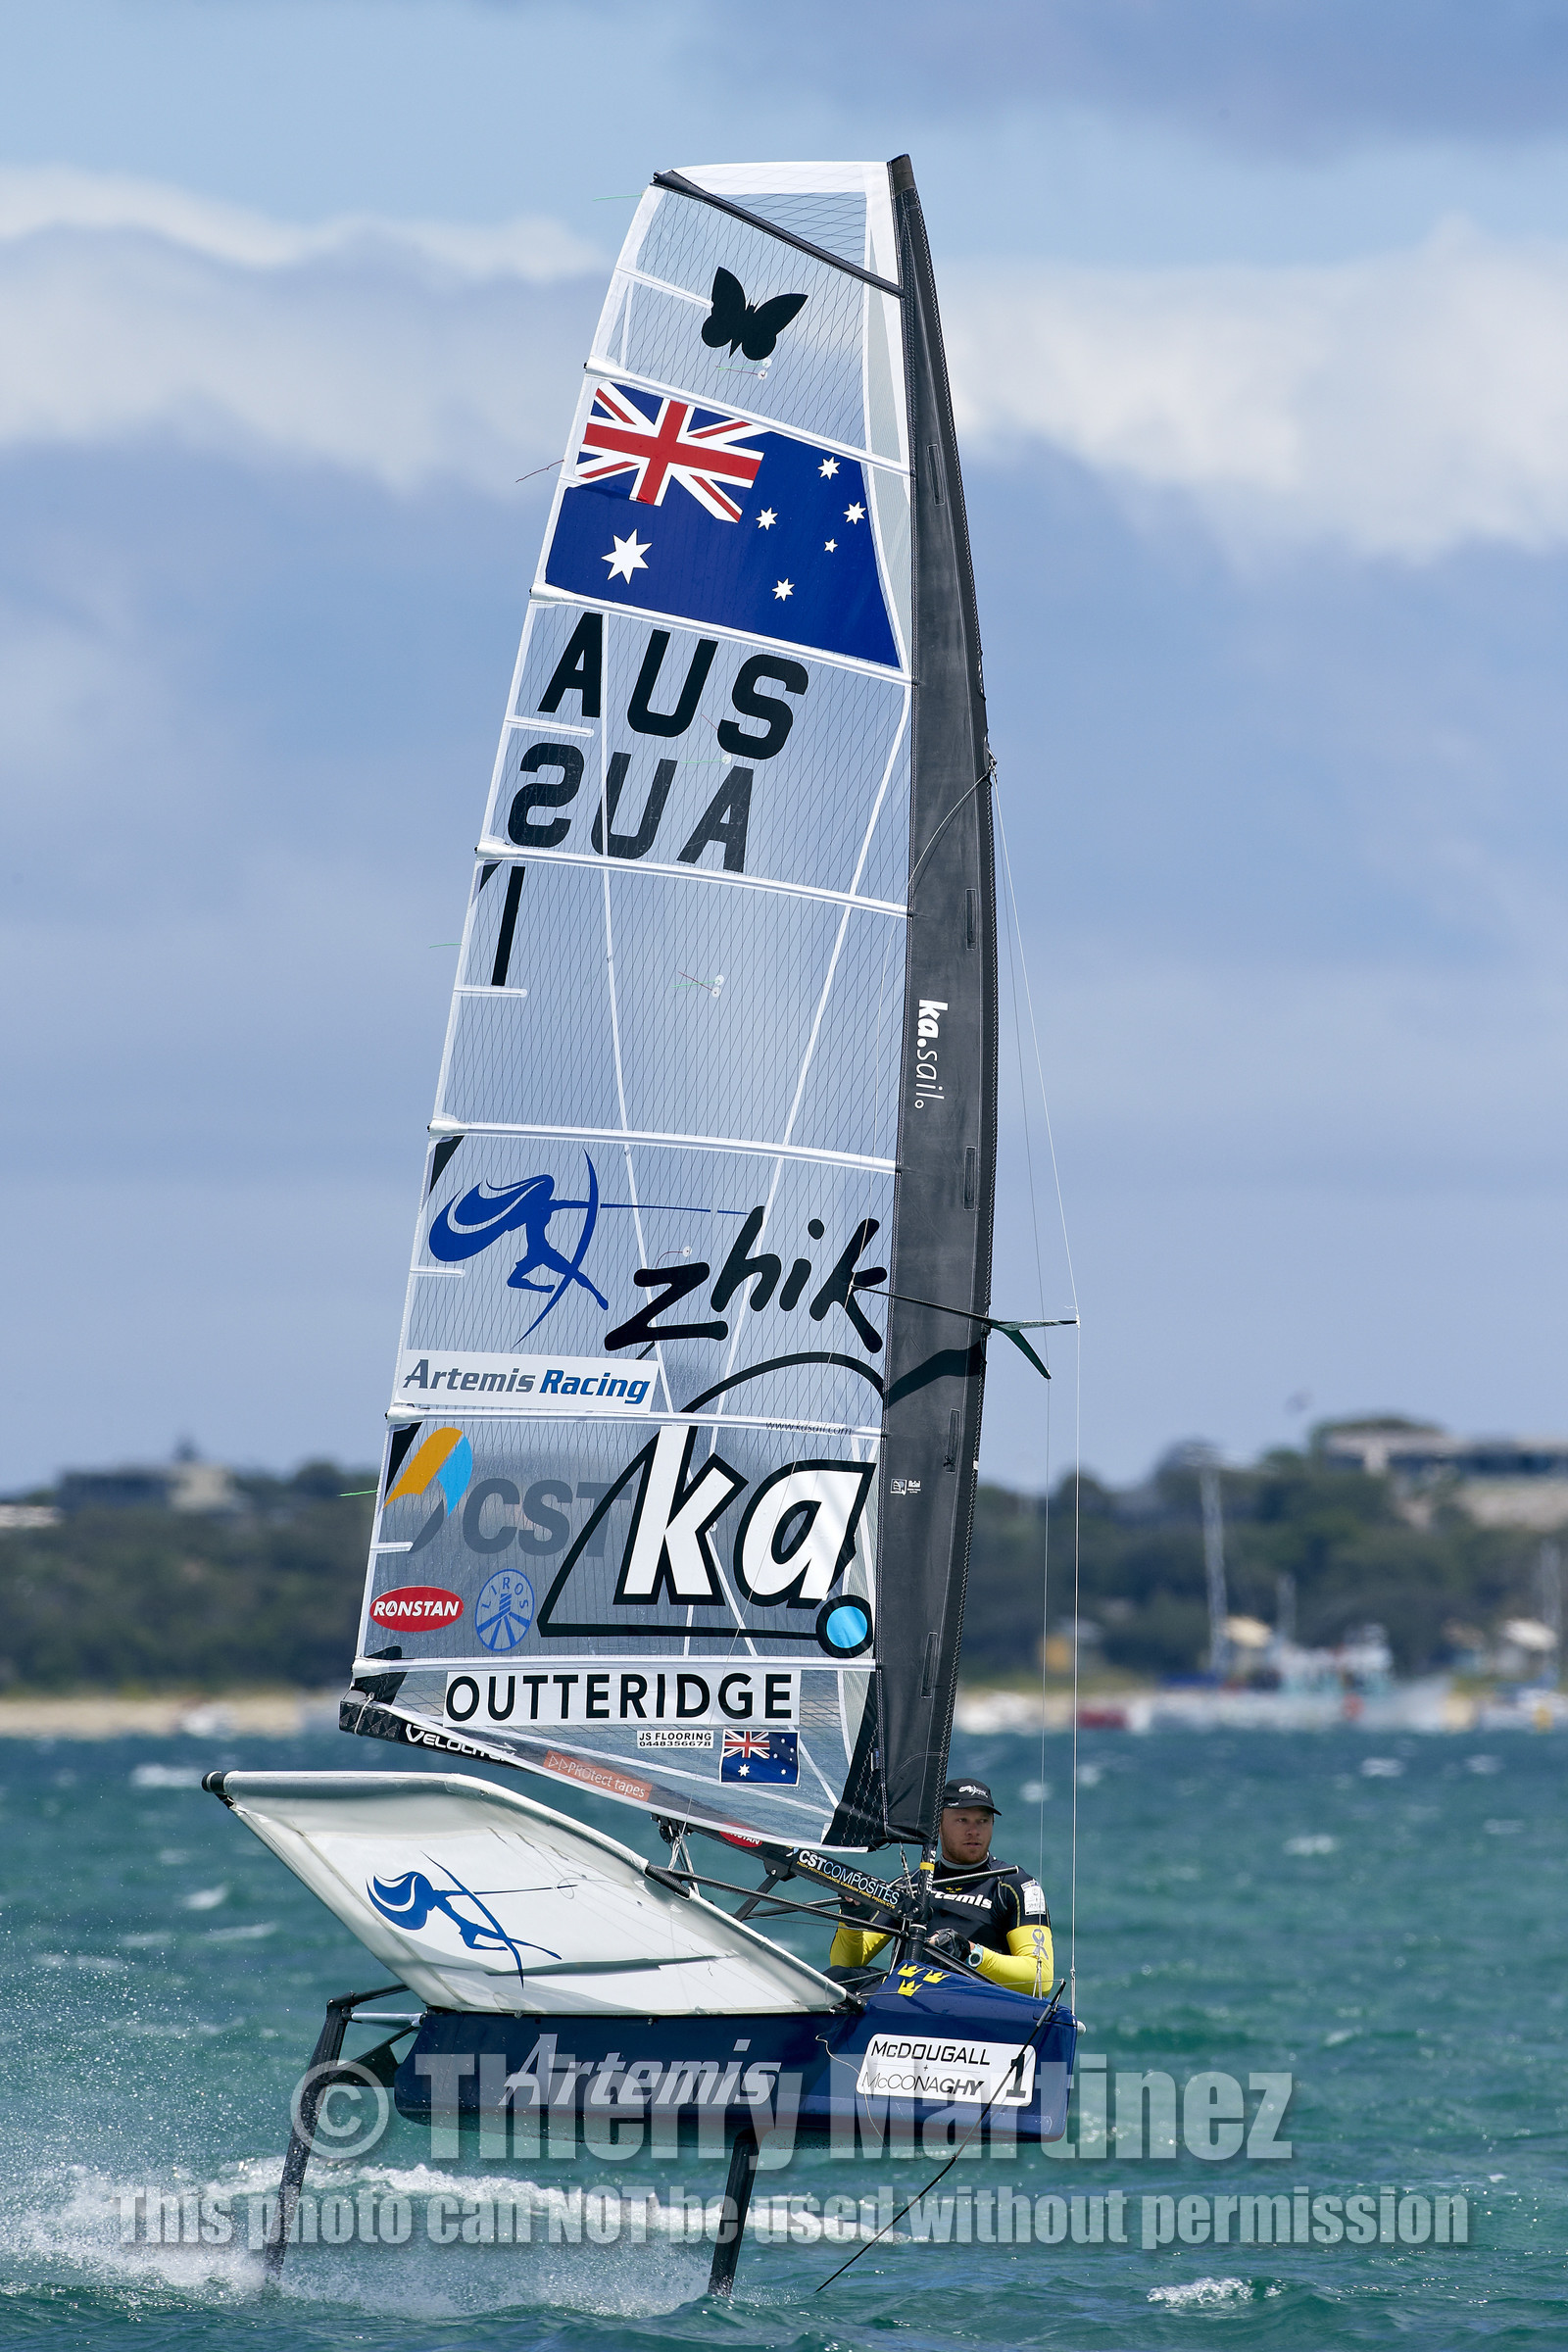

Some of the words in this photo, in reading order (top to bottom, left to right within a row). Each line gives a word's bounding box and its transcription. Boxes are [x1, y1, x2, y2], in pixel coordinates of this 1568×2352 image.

[537, 612, 809, 760] AUS
[604, 1205, 887, 1353] zhik
[403, 1358, 536, 1393] Artemis
[539, 1369, 651, 1404] Racing
[765, 1421, 853, 1436] www.kasail.com
[463, 1478, 633, 1558] CST
[373, 1600, 460, 1617] RONSTAN
[481, 1577, 529, 1609] LIROS
[446, 1672, 792, 1721] OUTTERIDGE
[639, 1732, 652, 1740] JS
[614, 1778, 646, 1798] tapes
[808, 1867, 840, 1884] PERFORMANCE
[840, 1881, 859, 1892] CARBON
[870, 2040, 991, 2066] McDOUGALL
[498, 2034, 782, 2105] Artemis
[861, 2072, 984, 2096] McCONAGHY
[1005, 2053, 1027, 2098] 1
